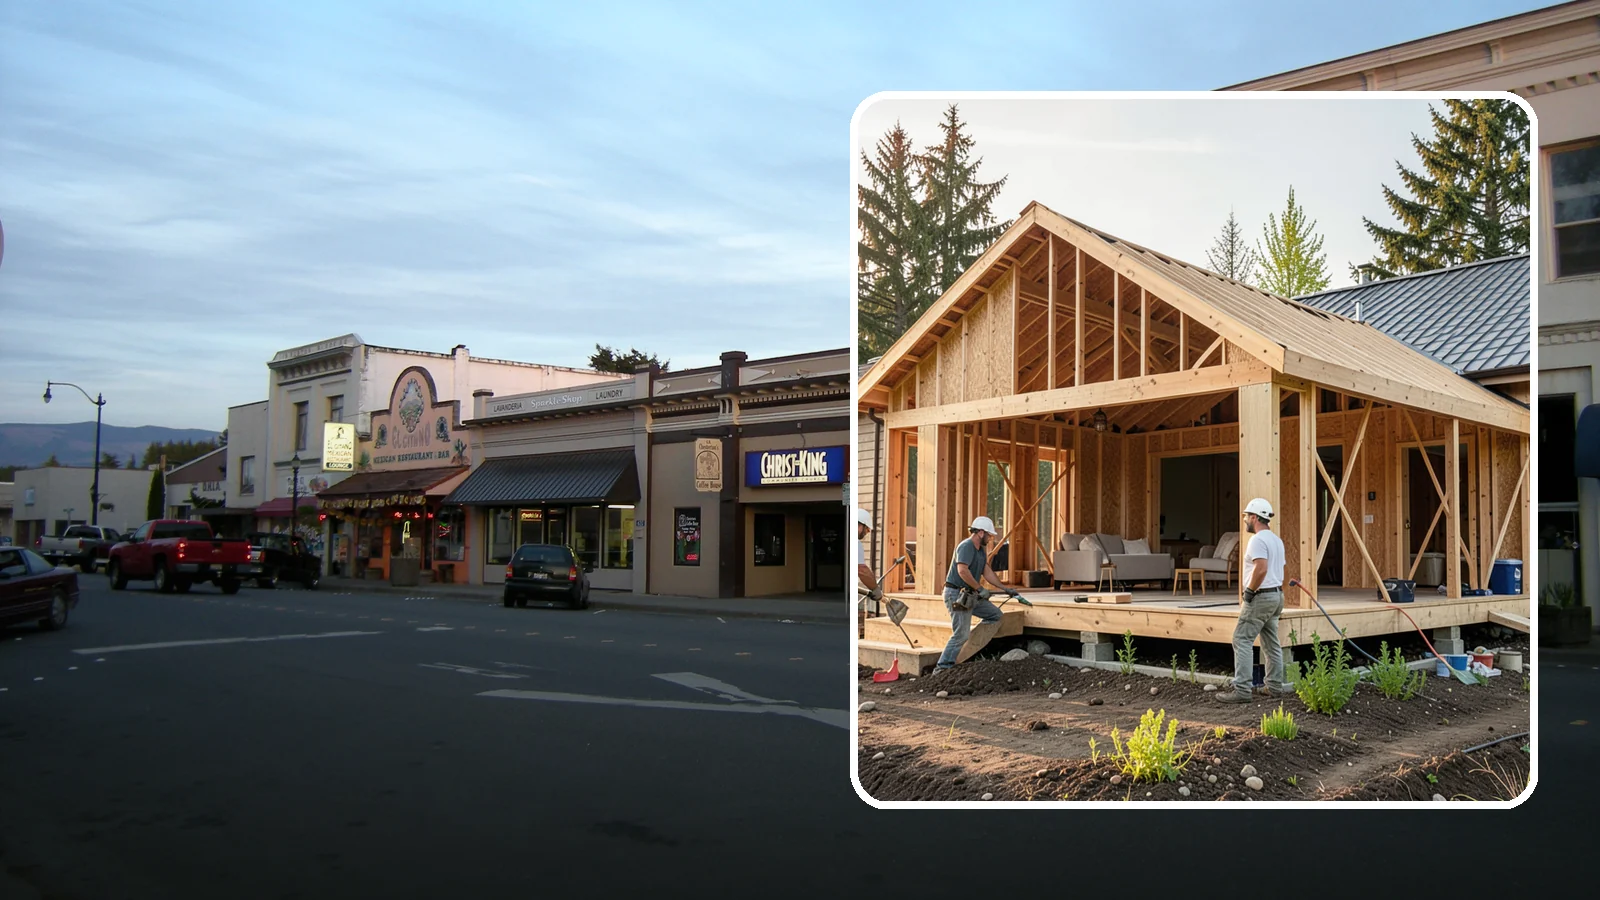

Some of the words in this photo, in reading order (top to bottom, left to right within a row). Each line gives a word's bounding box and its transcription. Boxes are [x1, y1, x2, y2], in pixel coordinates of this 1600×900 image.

[493, 402, 523, 413] LAVANDERIA
[562, 394, 583, 404] Shop
[596, 389, 624, 399] LAUNDRY
[374, 455, 396, 464] MEXICAN
[398, 451, 433, 462] RESTAURANT
[438, 450, 449, 459] BAR
[761, 452, 797, 478] CHRIST
[799, 450, 827, 476] KING
